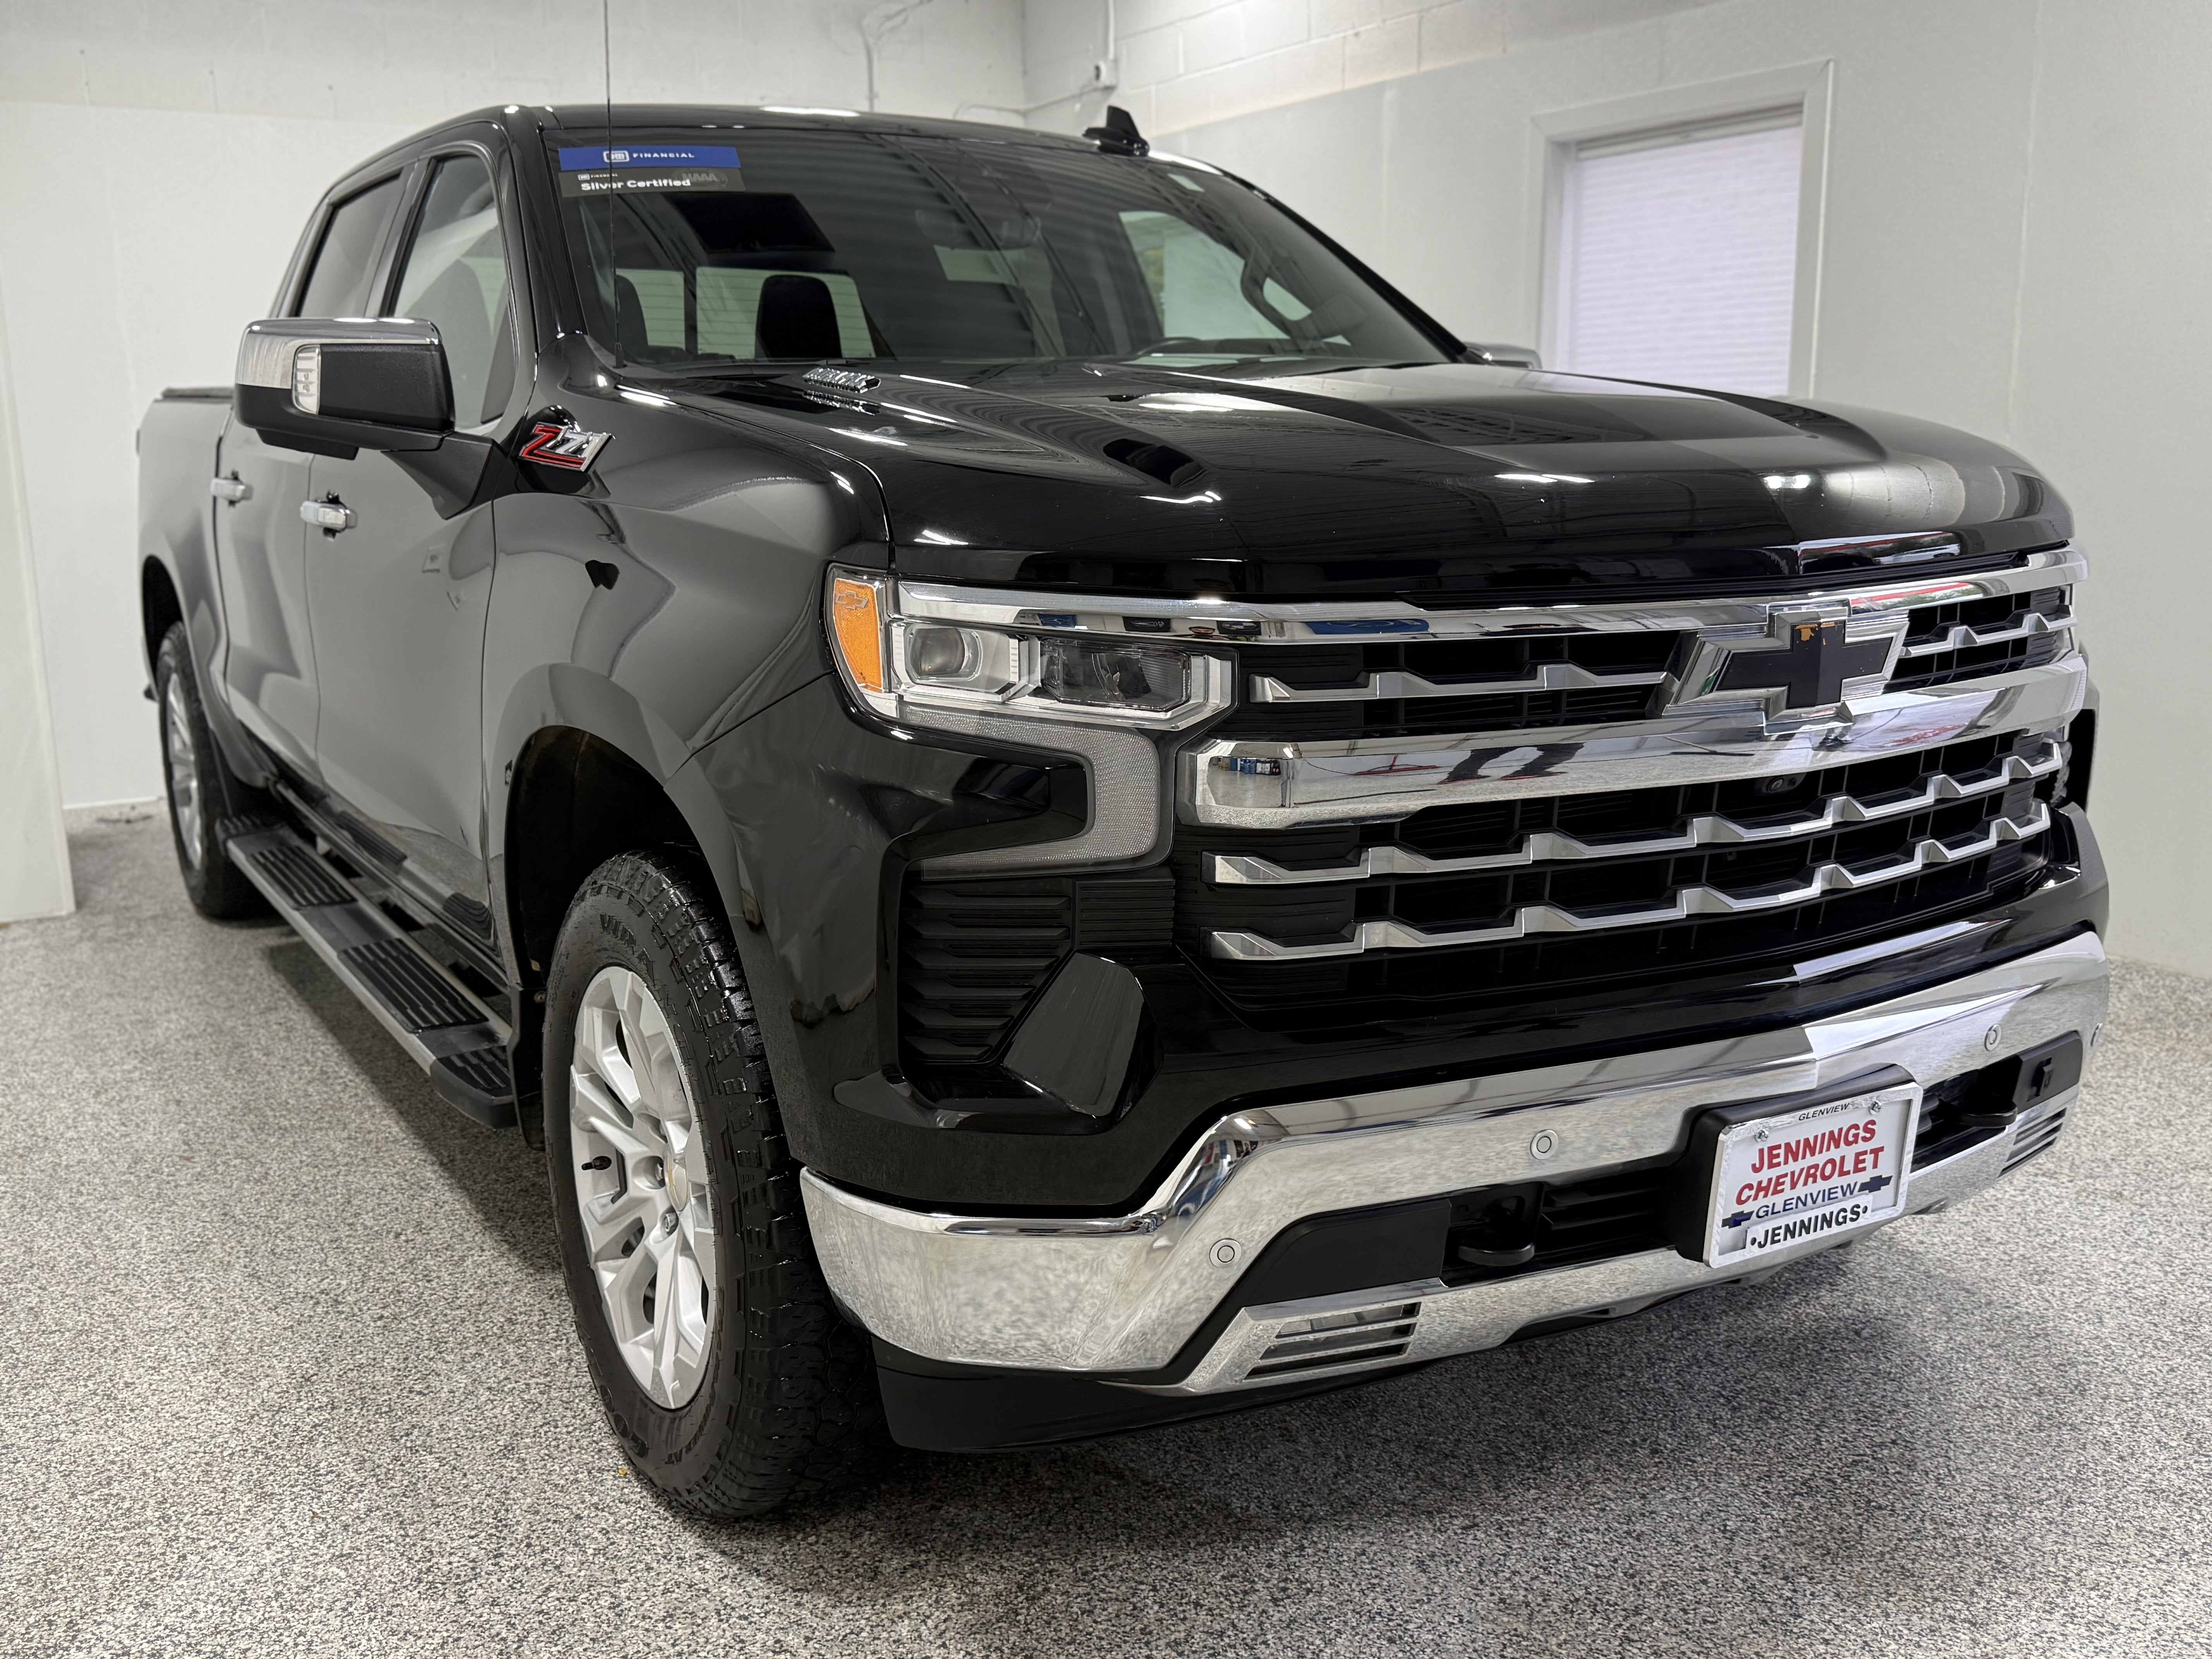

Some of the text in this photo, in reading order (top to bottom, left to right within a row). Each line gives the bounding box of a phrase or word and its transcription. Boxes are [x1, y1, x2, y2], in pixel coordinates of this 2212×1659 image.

[581, 178, 691, 190] Silver Certified
[519, 421, 612, 472] Z71
[1798, 1102, 1850, 1121] GLENVIEW
[1751, 1119, 1877, 1174] JENNINGS
[1735, 1146, 1885, 1206] CHEVROLET
[1755, 1181, 1858, 1219] GLENVIEW
